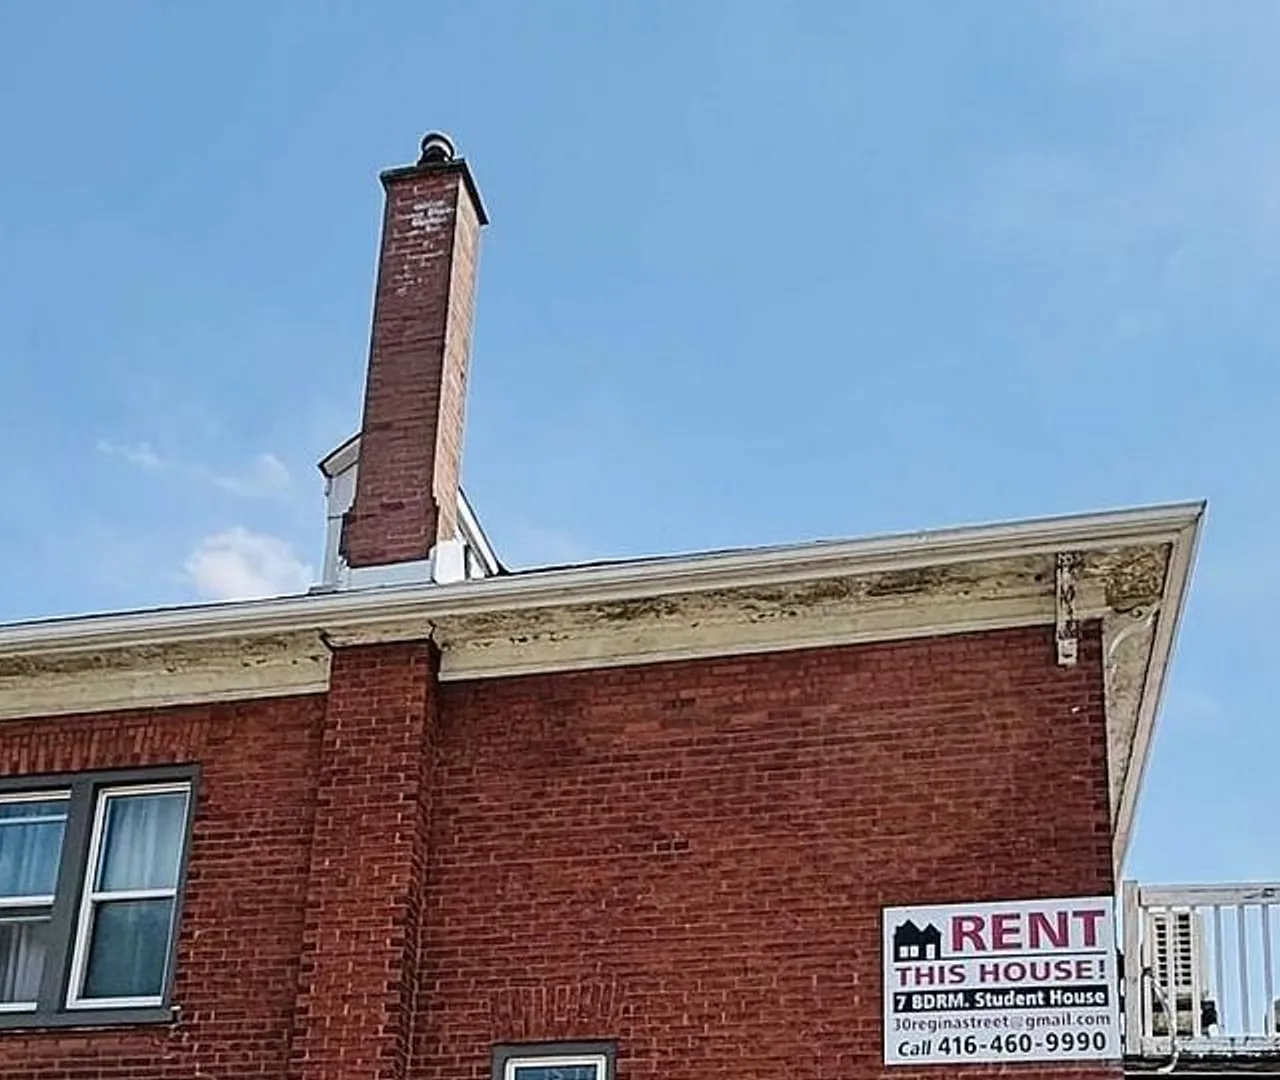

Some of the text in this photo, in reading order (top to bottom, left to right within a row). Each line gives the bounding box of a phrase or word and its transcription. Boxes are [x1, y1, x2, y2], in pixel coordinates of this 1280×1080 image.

[950, 910, 1106, 951] RENT
[895, 959, 1106, 987] THIS HOUSE!
[896, 989, 1106, 1010] 7 BDRM. Student House
[898, 1031, 1107, 1057] Call 416-460-9990
